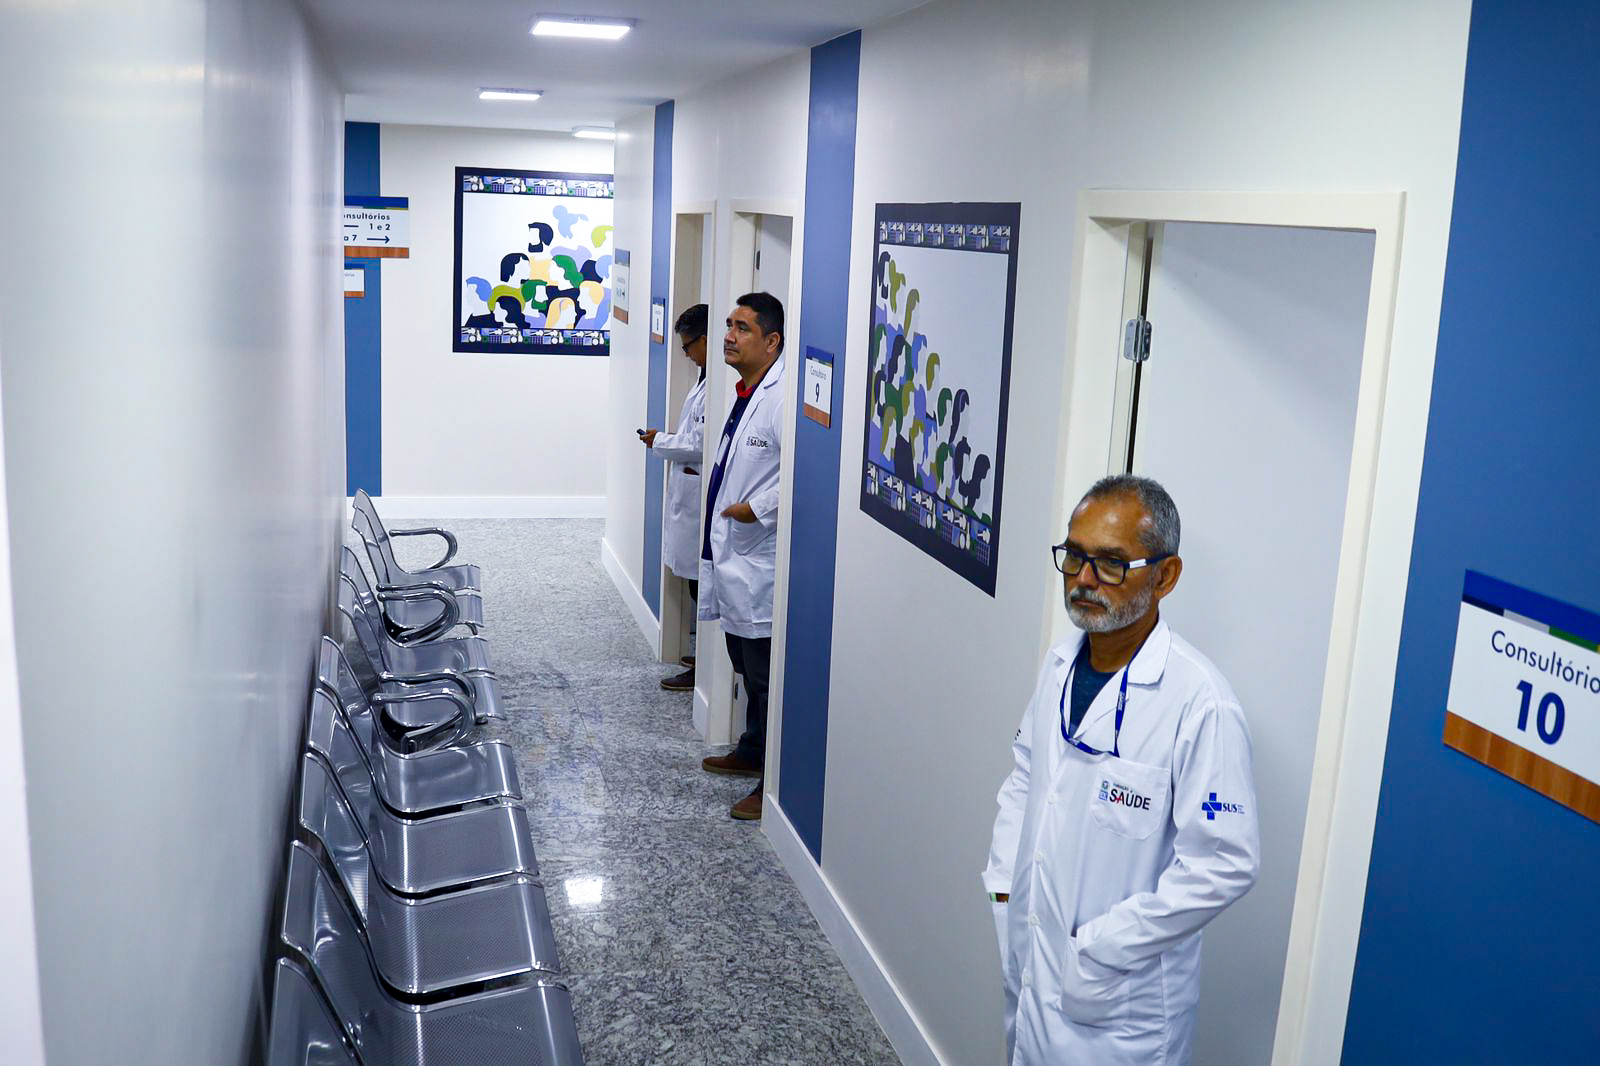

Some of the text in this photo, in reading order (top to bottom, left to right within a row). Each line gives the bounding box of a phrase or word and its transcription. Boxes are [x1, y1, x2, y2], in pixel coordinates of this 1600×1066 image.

[385, 223, 391, 231] 2
[815, 382, 820, 403] 9
[1491, 630, 1600, 694] Consultório
[1516, 679, 1566, 745] 10
[1109, 788, 1152, 811] SAÚDE
[1222, 802, 1238, 813] SUS
